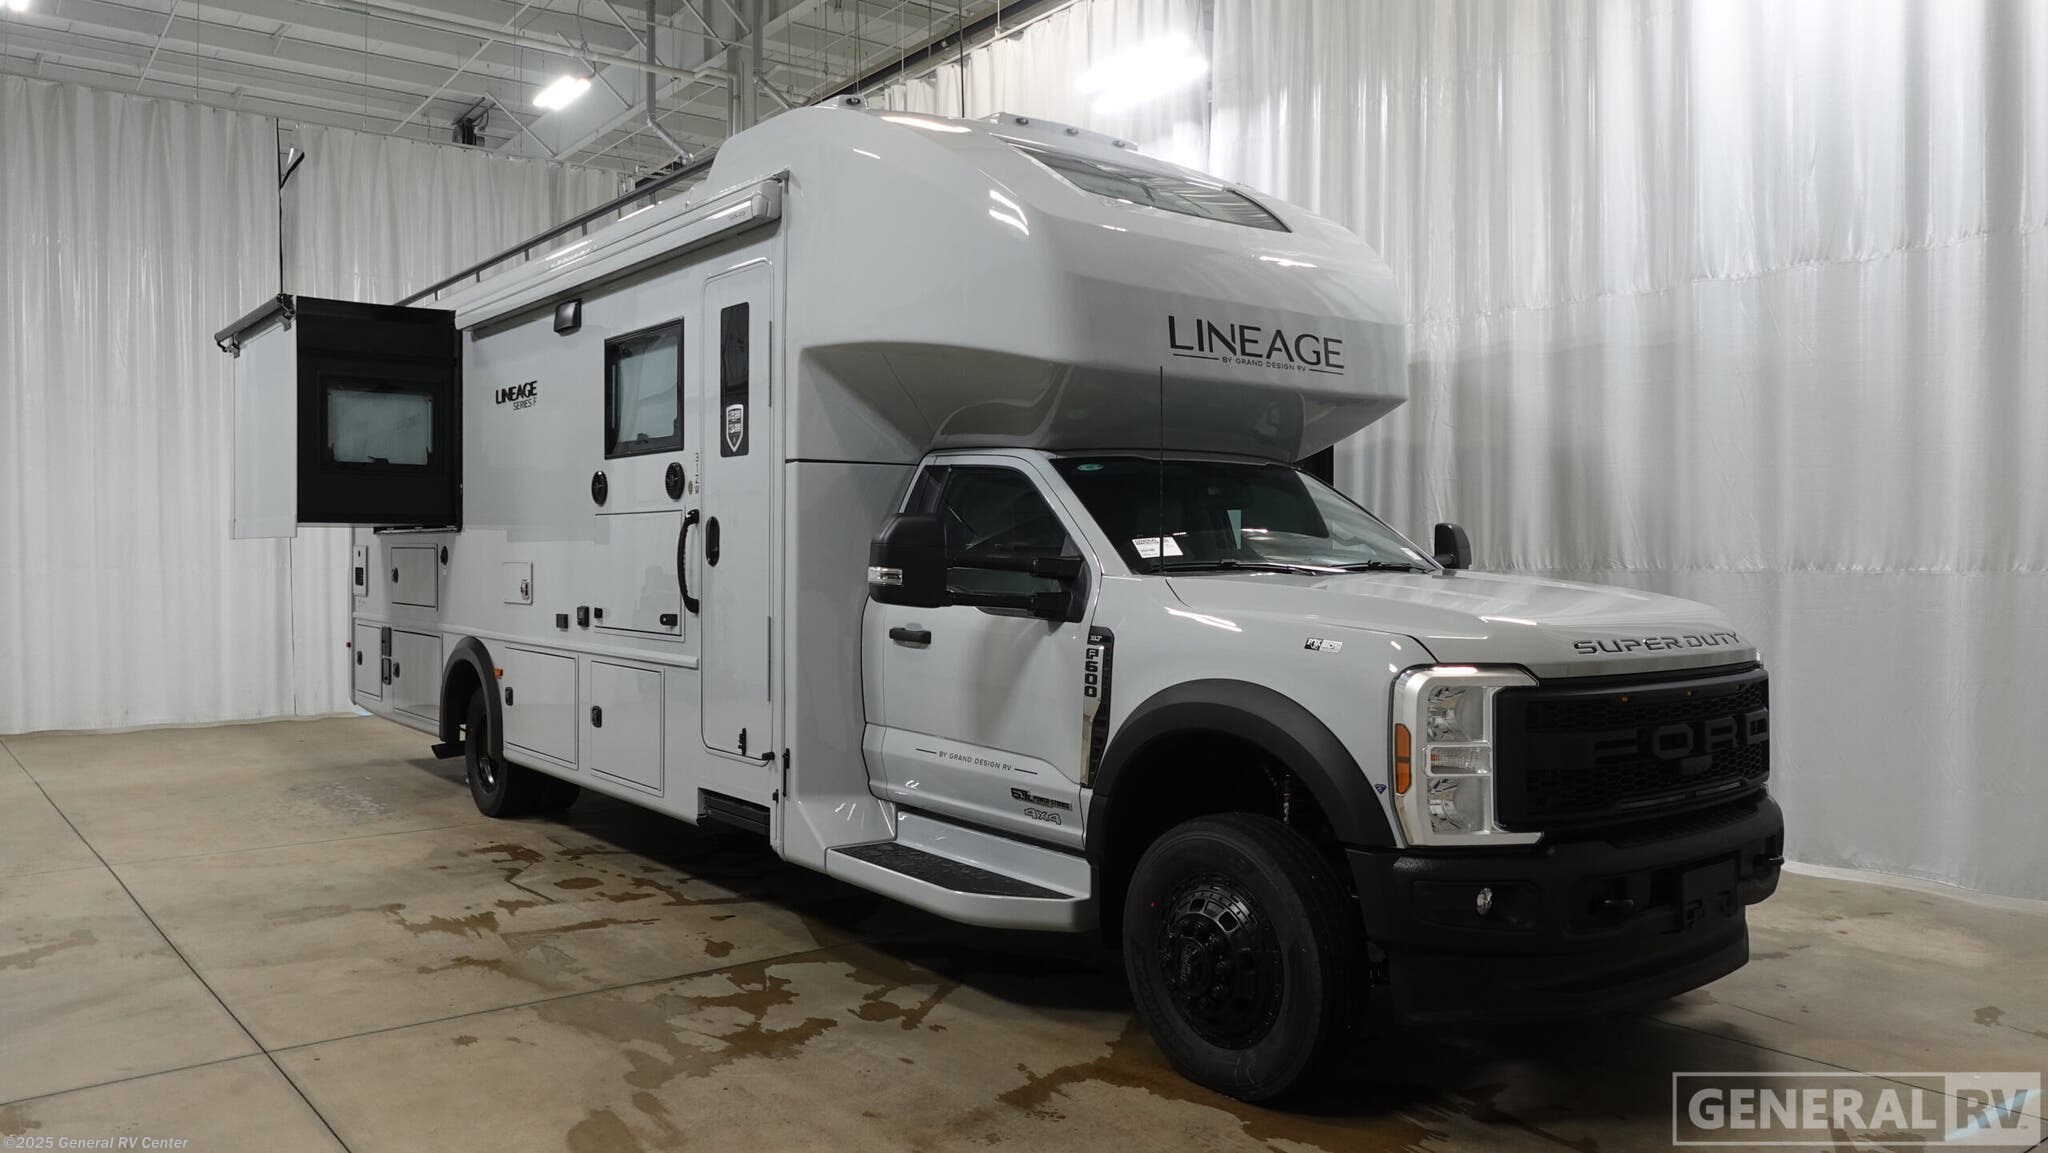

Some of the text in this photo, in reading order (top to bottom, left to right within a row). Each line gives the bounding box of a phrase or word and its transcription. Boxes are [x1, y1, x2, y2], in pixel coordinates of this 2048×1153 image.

[1168, 315, 1345, 369] LINEAGE
[1222, 356, 1232, 364] BY
[1235, 359, 1263, 368] GRAND
[1266, 361, 1295, 371] DESIGN
[1574, 631, 1740, 655] SUPER DUTY
[1084, 648, 1099, 698] F600
[1587, 708, 1769, 767] FORD
[938, 750, 1012, 771] BY GRAND DESIGN RV
